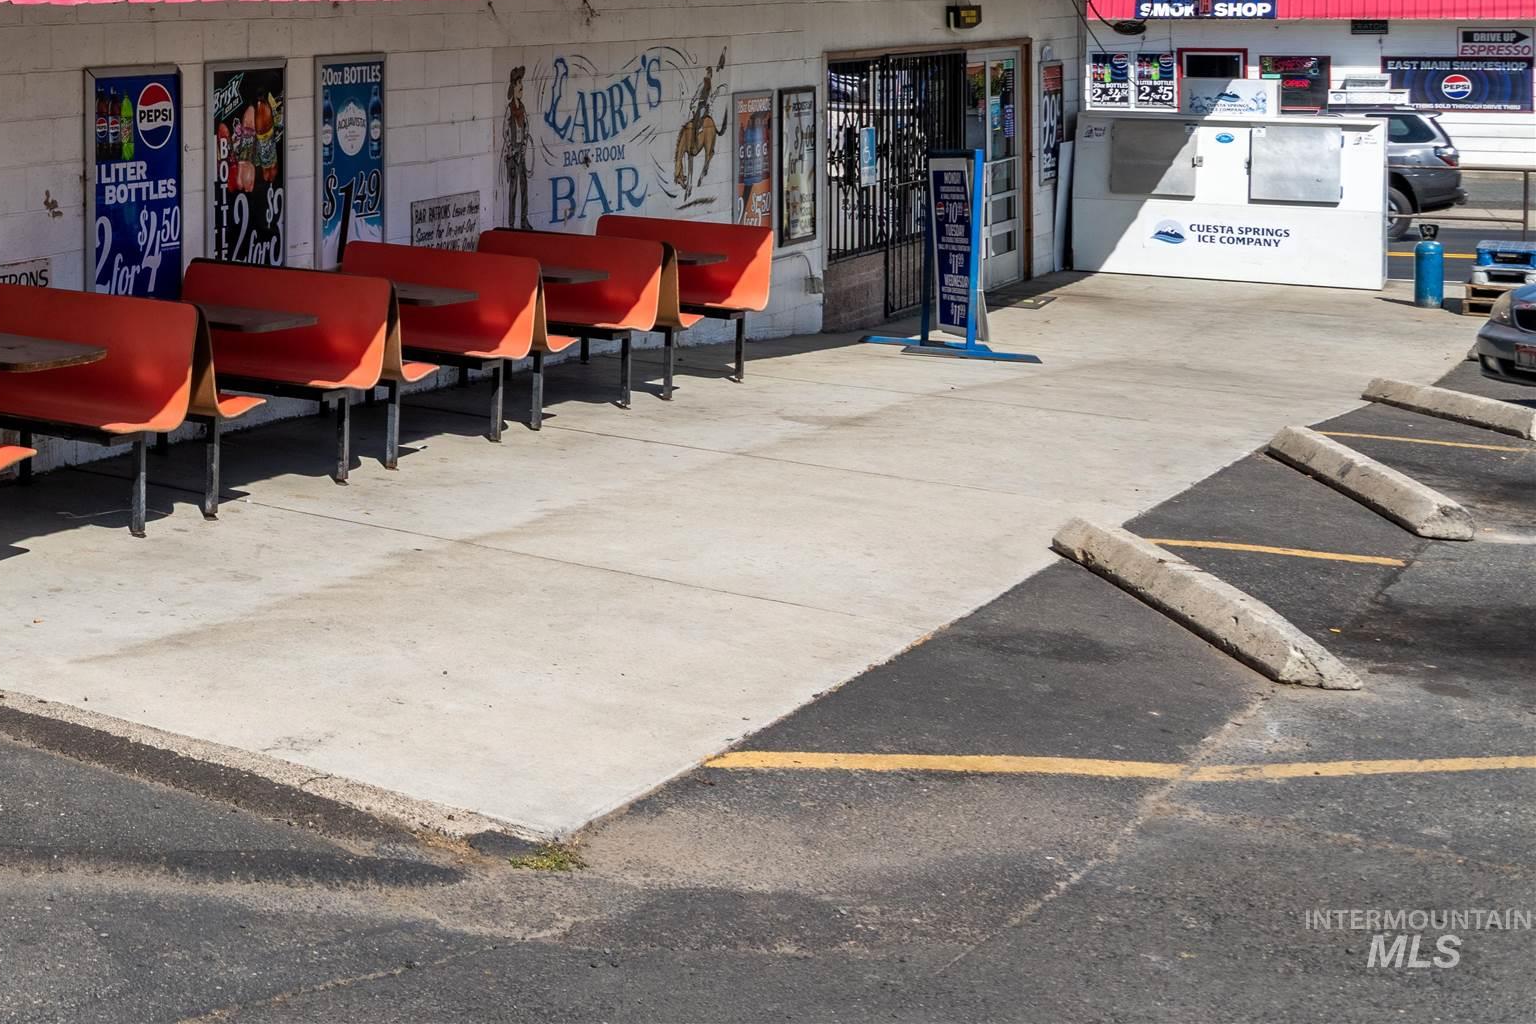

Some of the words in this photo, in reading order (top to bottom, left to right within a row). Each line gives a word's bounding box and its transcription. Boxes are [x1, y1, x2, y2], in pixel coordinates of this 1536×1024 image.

[1140, 3, 1211, 17] SMOK
[1214, 3, 1271, 17] SHOP
[1473, 32, 1502, 42] DRIVE
[1504, 32, 1517, 42] UP
[1460, 45, 1531, 56] ESPRESSO
[1387, 61, 1418, 70] EAST
[1420, 61, 1451, 70] MAIN
[1453, 61, 1528, 71] SMOKESHOP
[343, 65, 382, 84] BOTTLES
[544, 54, 662, 144] LARRY'S
[1092, 88, 1102, 101] 2
[1139, 86, 1151, 101] 2
[1157, 86, 1173, 101] $5
[139, 108, 172, 124] PEPSI
[101, 160, 148, 184] LITER
[105, 178, 177, 205] BOTTLES
[548, 166, 648, 224] BAR
[232, 192, 249, 263] 2
[1189, 223, 1234, 235] CUESTA
[1238, 226, 1290, 238] SPRINGS
[1197, 234, 1215, 243] ICE
[1219, 235, 1281, 248] COMPANY
[96, 215, 113, 294] 2
[110, 252, 141, 296] for
